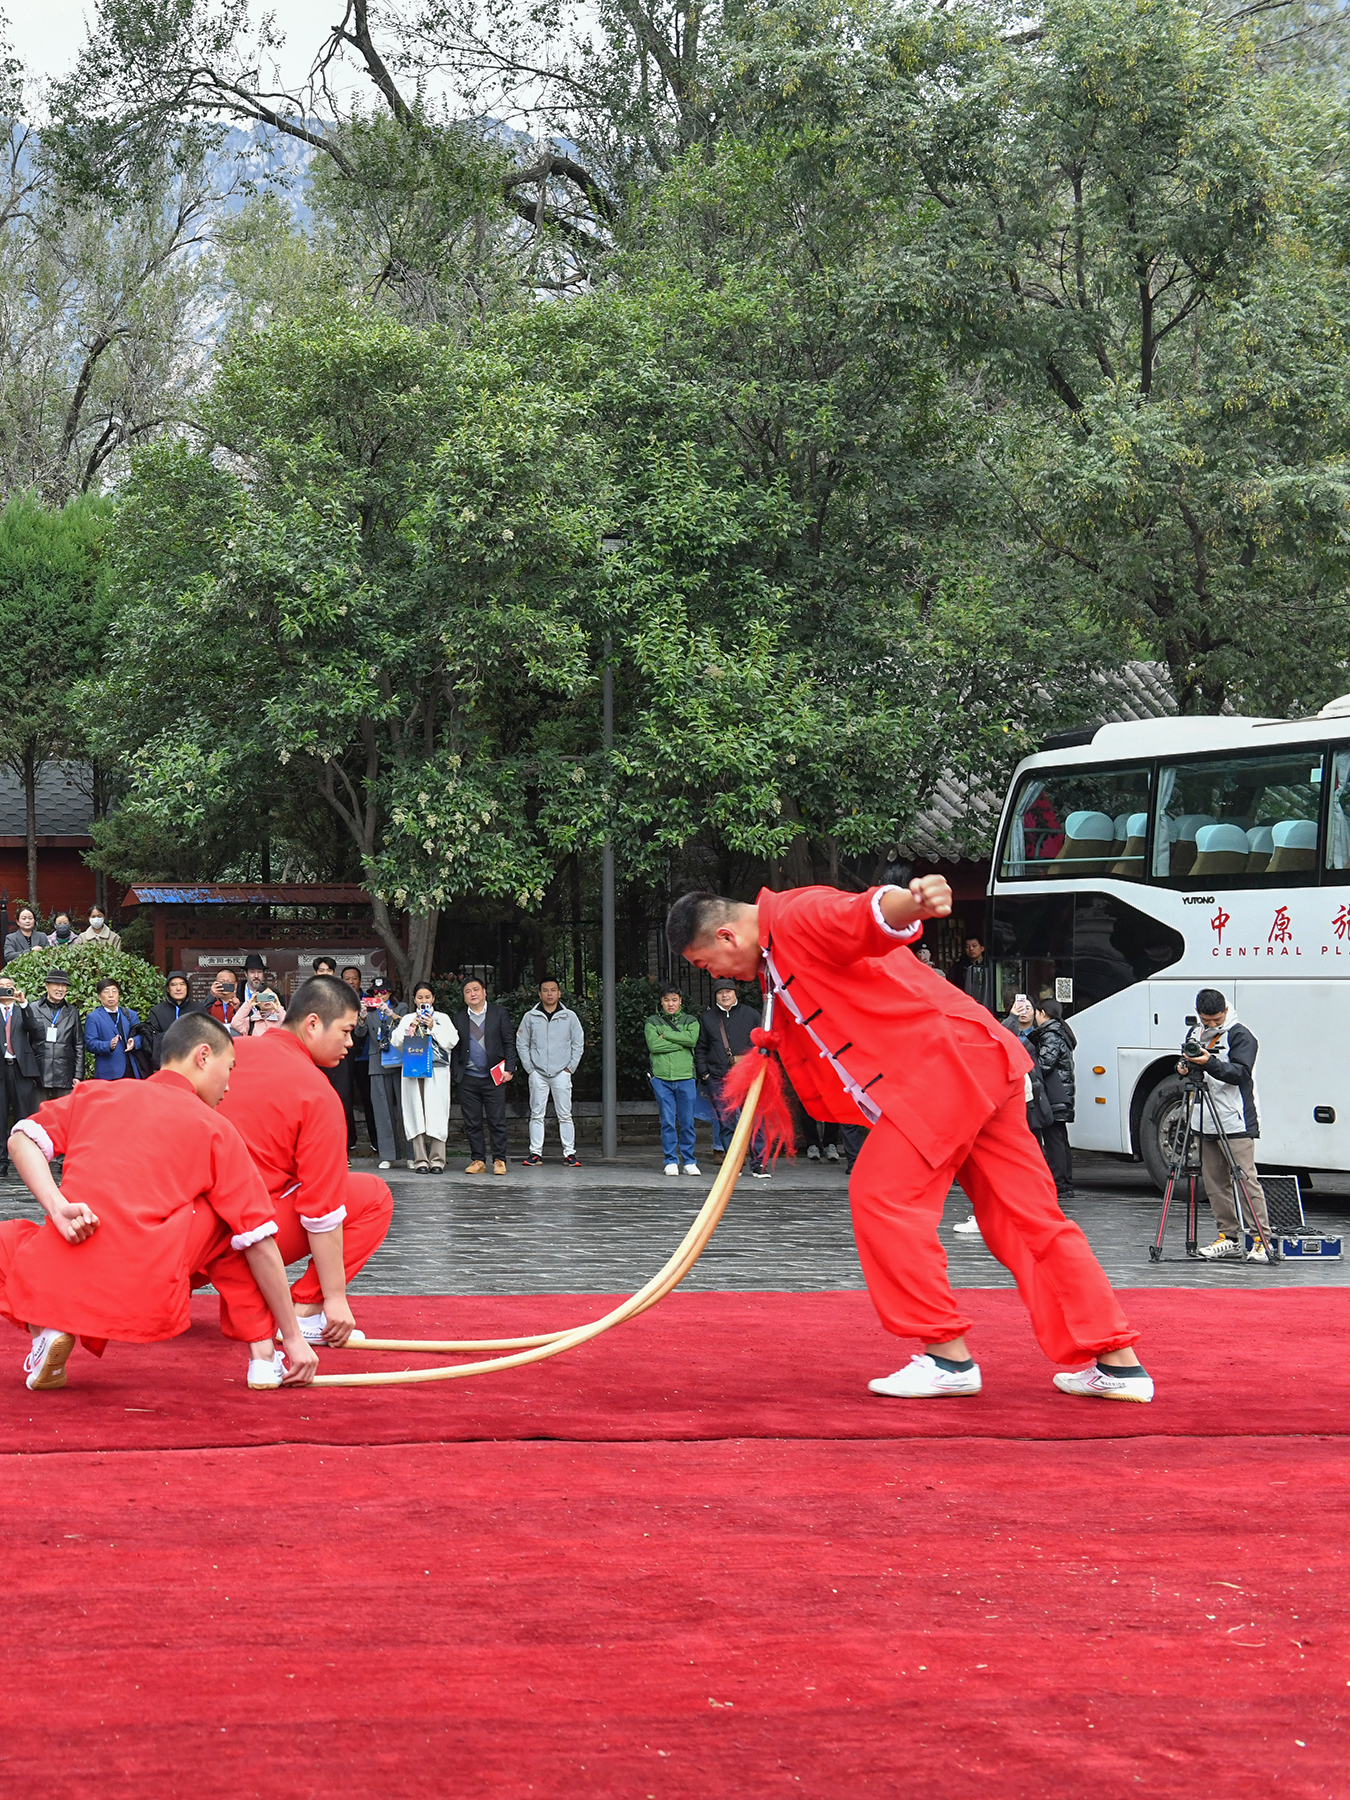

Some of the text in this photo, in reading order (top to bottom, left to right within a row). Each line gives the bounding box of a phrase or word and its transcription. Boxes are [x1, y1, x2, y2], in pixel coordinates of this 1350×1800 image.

[1182, 896, 1216, 905] YUTONG
[1212, 945, 1350, 957] CENTRAL PL
